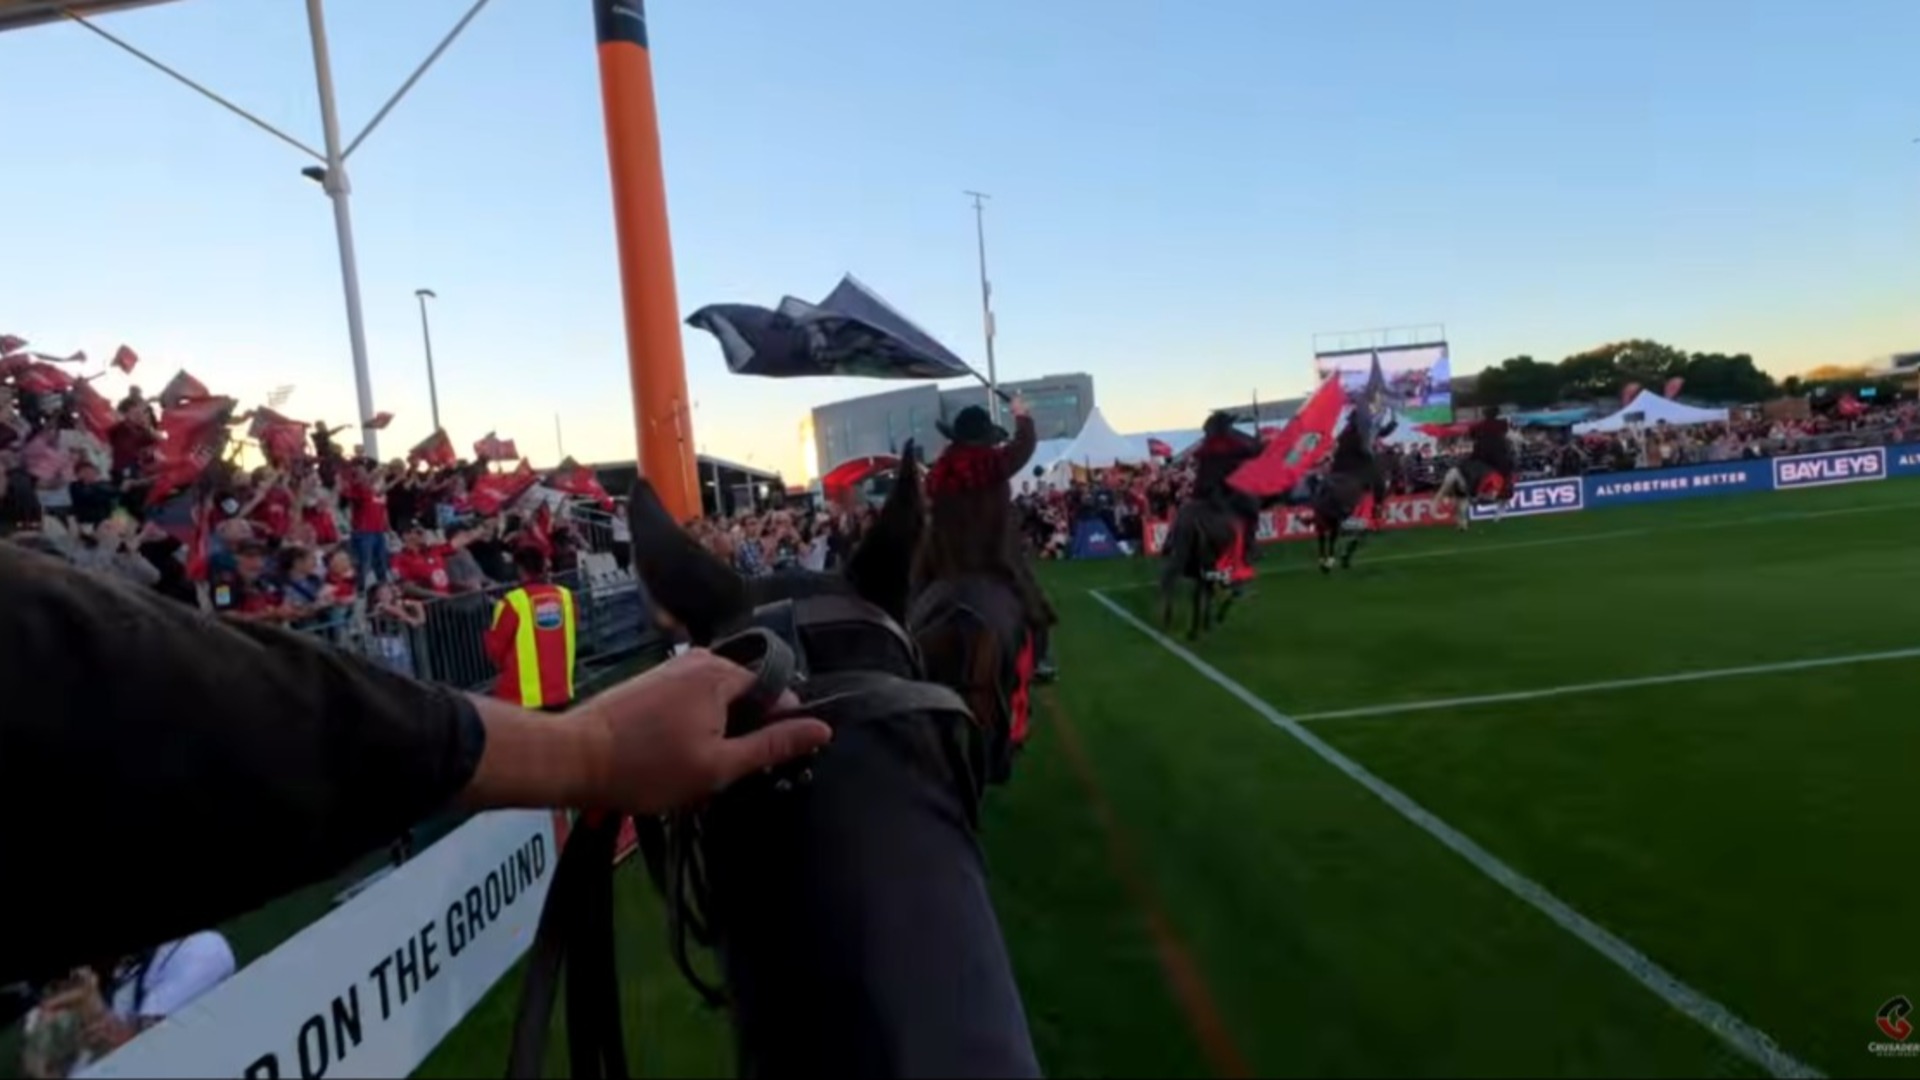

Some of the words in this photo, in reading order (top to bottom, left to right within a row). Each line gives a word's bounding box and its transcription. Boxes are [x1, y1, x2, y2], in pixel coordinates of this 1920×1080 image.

[1780, 454, 1879, 482] BAYLEYS
[1596, 476, 1688, 497] ALTOGETHER
[1693, 471, 1747, 487] BETTER
[1385, 498, 1453, 526] KFC
[1477, 484, 1577, 513] YLEYS
[297, 982, 363, 1080] ON
[368, 920, 441, 1021] THE
[446, 831, 546, 958] GROUND
